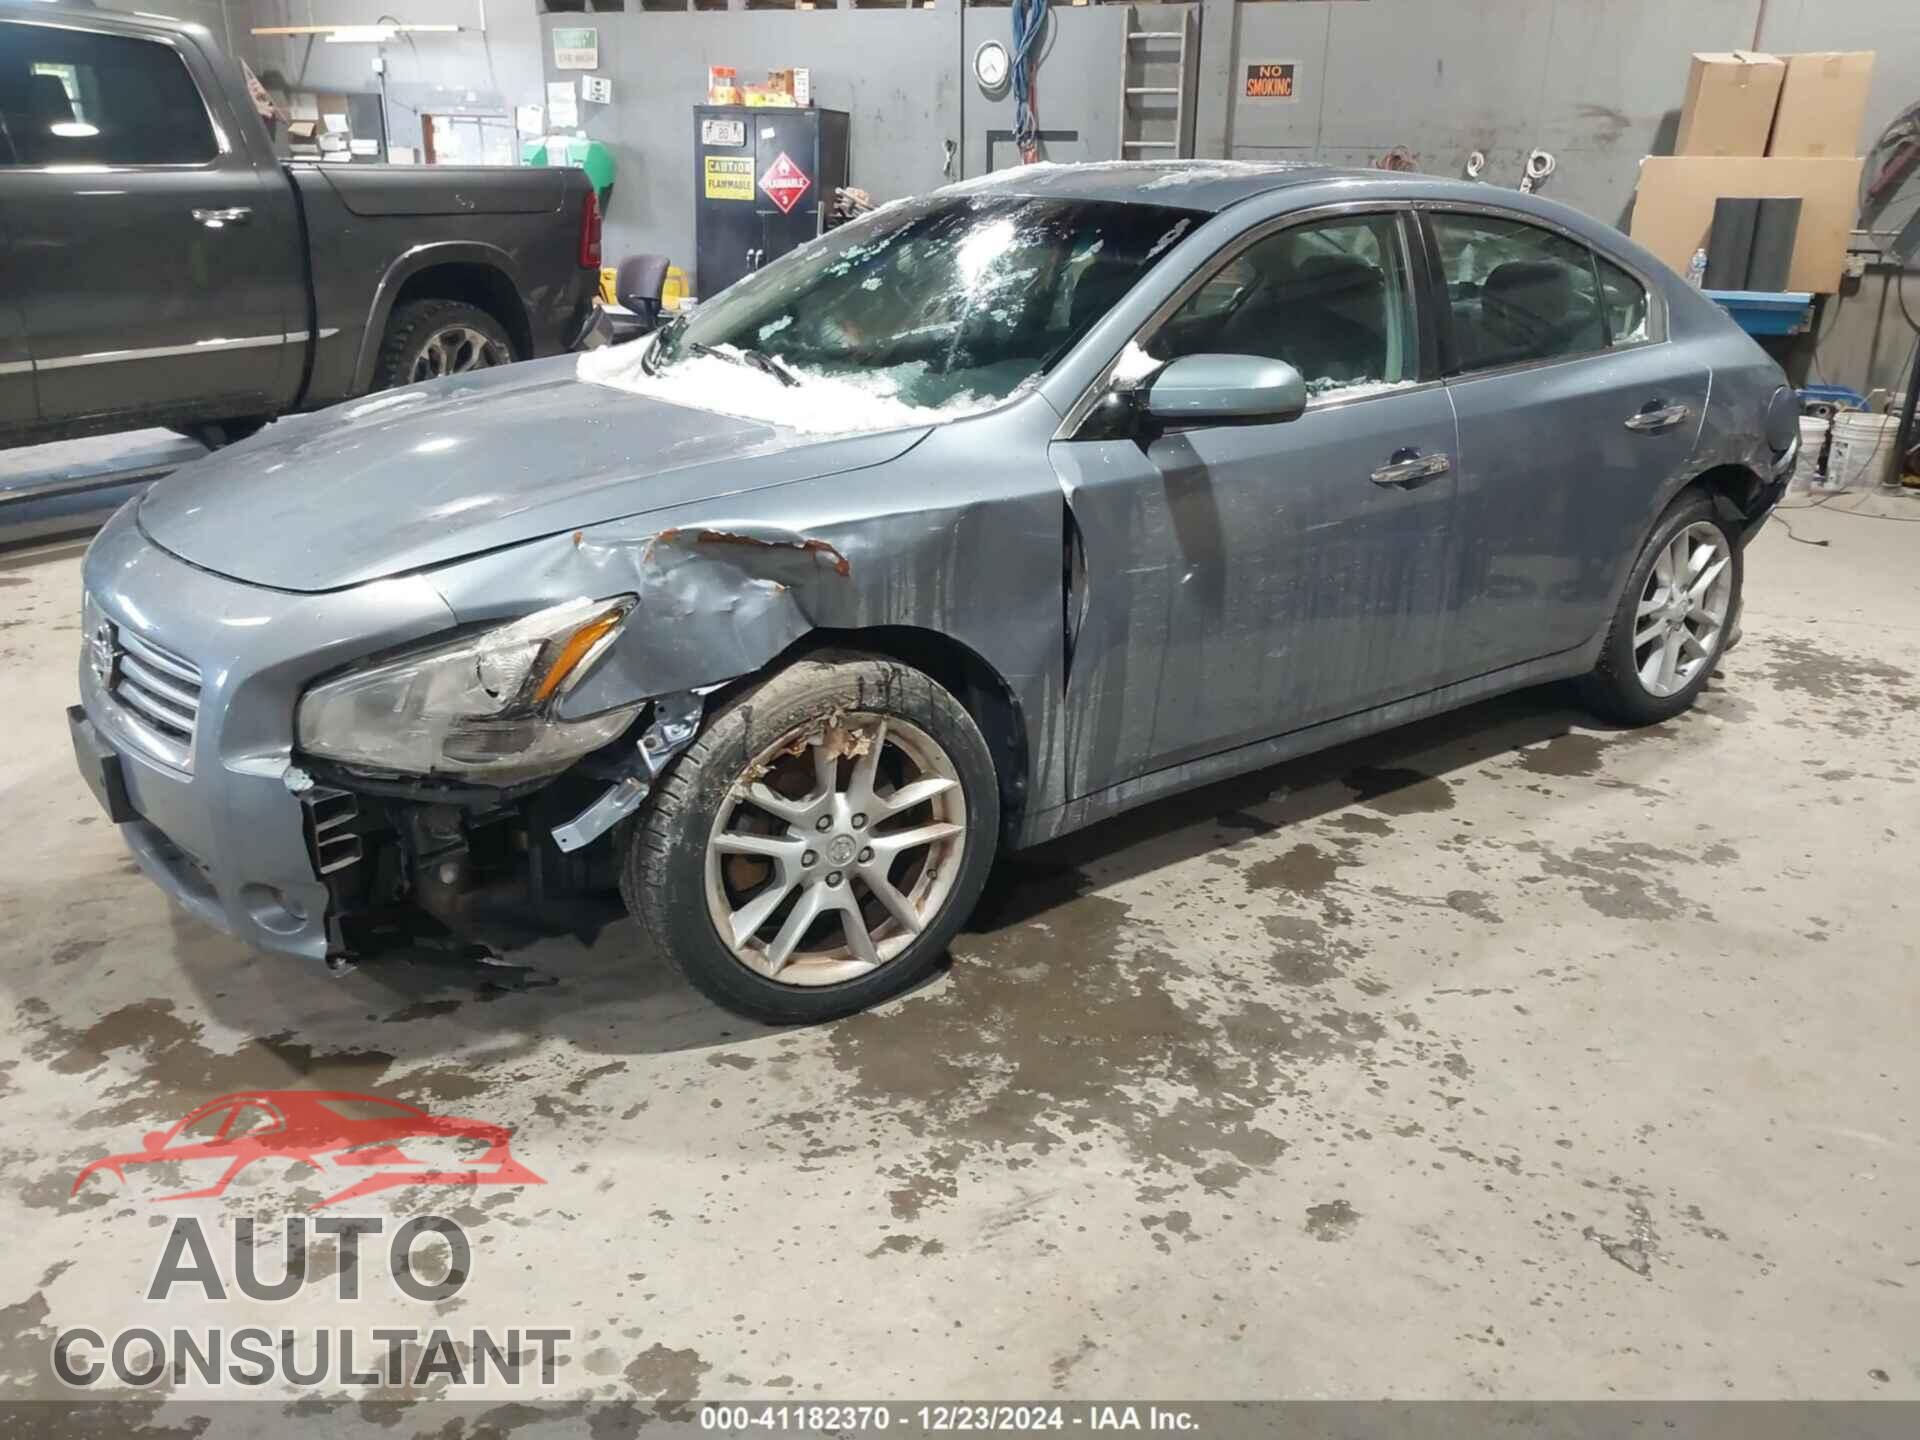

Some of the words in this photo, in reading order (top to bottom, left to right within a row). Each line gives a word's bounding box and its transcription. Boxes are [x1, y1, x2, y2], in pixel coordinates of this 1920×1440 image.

[1260, 66, 1282, 77] NO
[1248, 78, 1291, 96] SMOKING
[708, 160, 752, 174] CAUTION
[708, 179, 752, 190] FLAMMABLE
